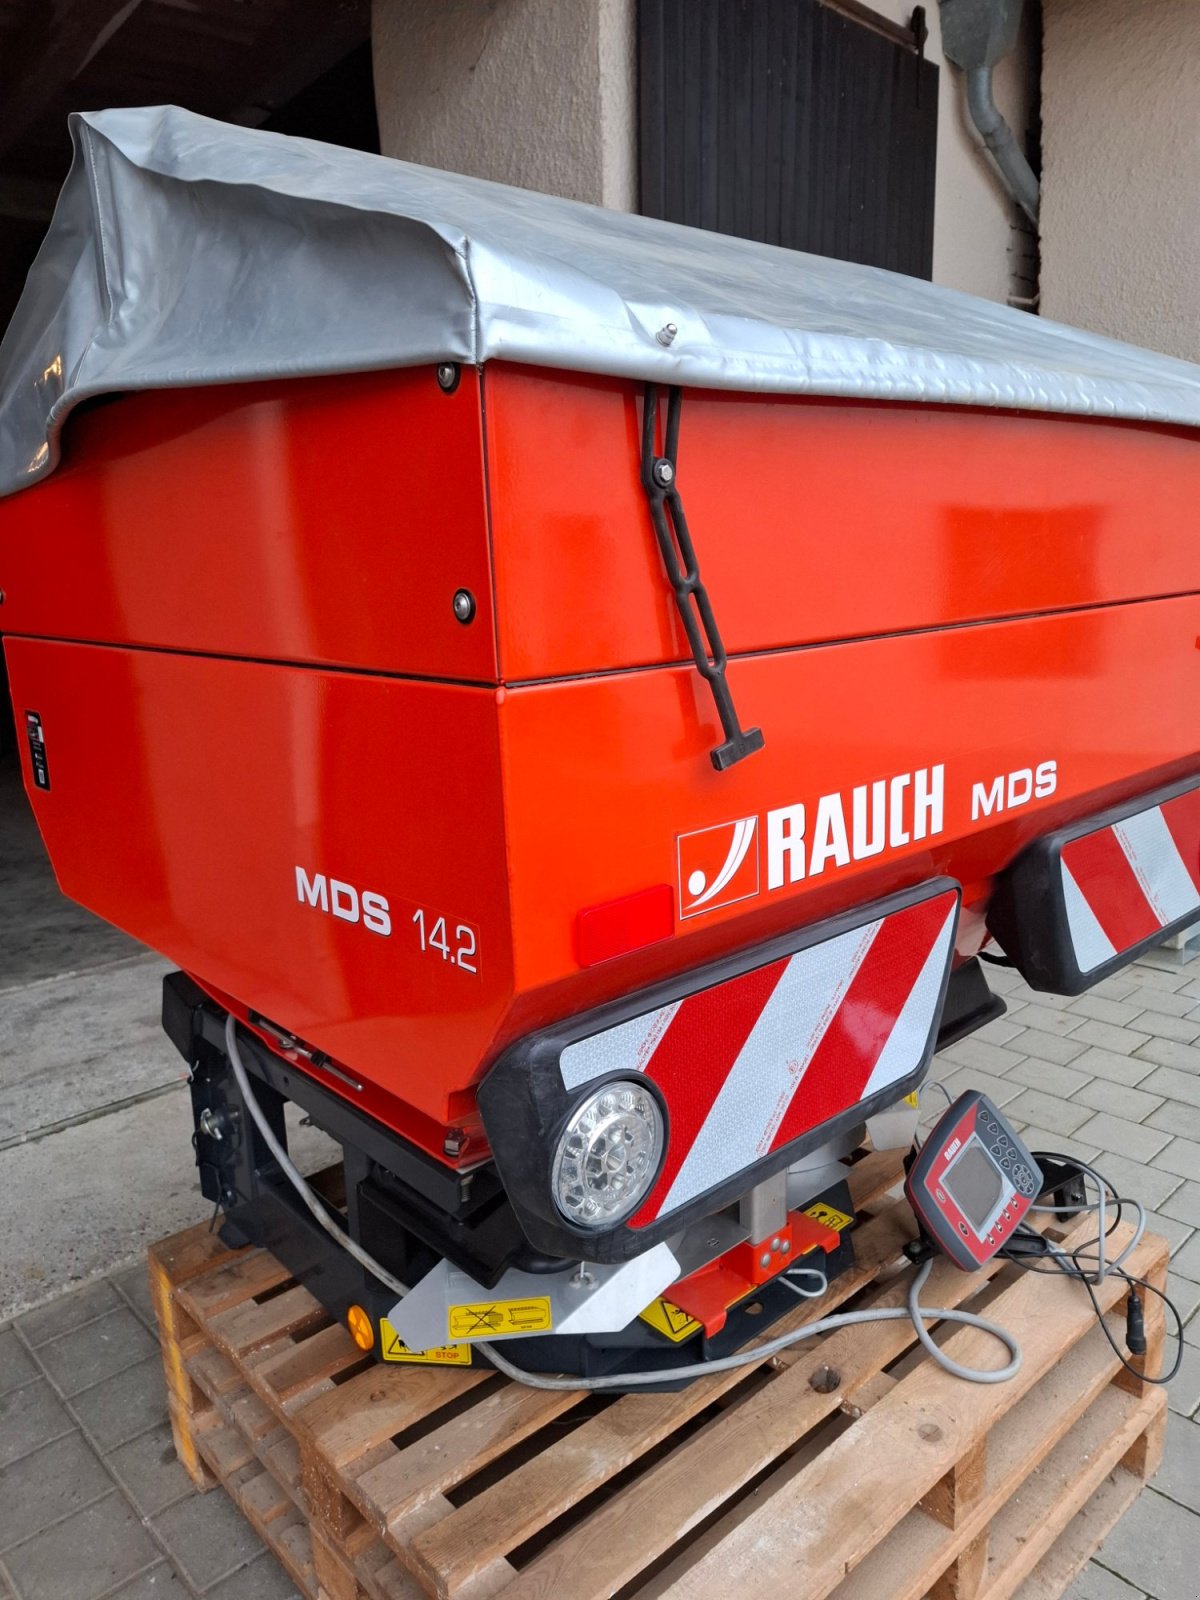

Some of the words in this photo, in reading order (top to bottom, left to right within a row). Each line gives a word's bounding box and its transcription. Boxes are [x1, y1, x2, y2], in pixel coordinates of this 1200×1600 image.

[767, 764, 945, 891] RAUCH
[971, 760, 1057, 821] MDS
[295, 865, 392, 938] MDS
[412, 908, 477, 974] 14.2
[435, 1351, 460, 1359] STOP
